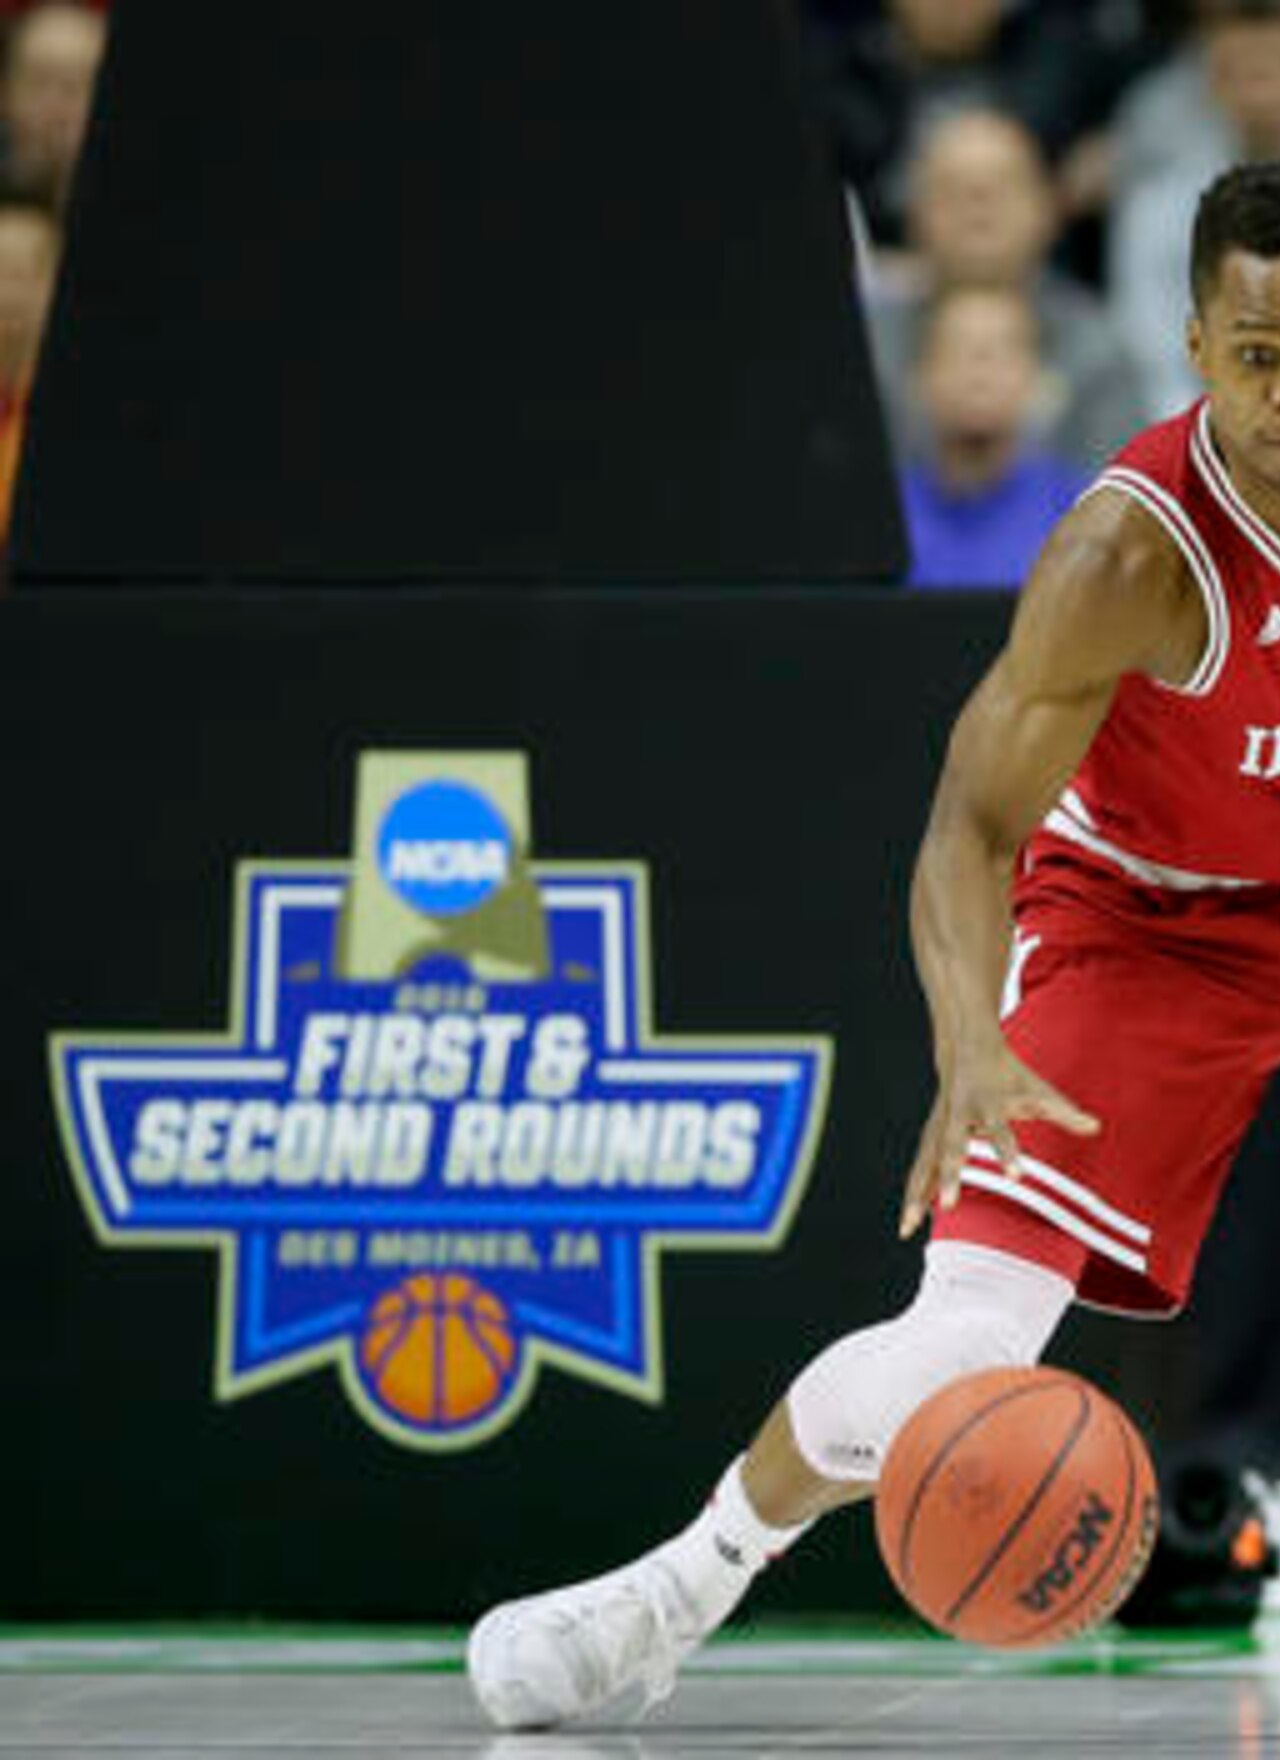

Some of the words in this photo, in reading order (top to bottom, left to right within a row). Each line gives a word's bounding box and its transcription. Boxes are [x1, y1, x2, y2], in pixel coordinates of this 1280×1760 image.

[293, 1014, 525, 1099] FIRST
[523, 1014, 591, 1100] &
[130, 1099, 434, 1187] SECOND
[442, 1101, 761, 1188] ROUNDS
